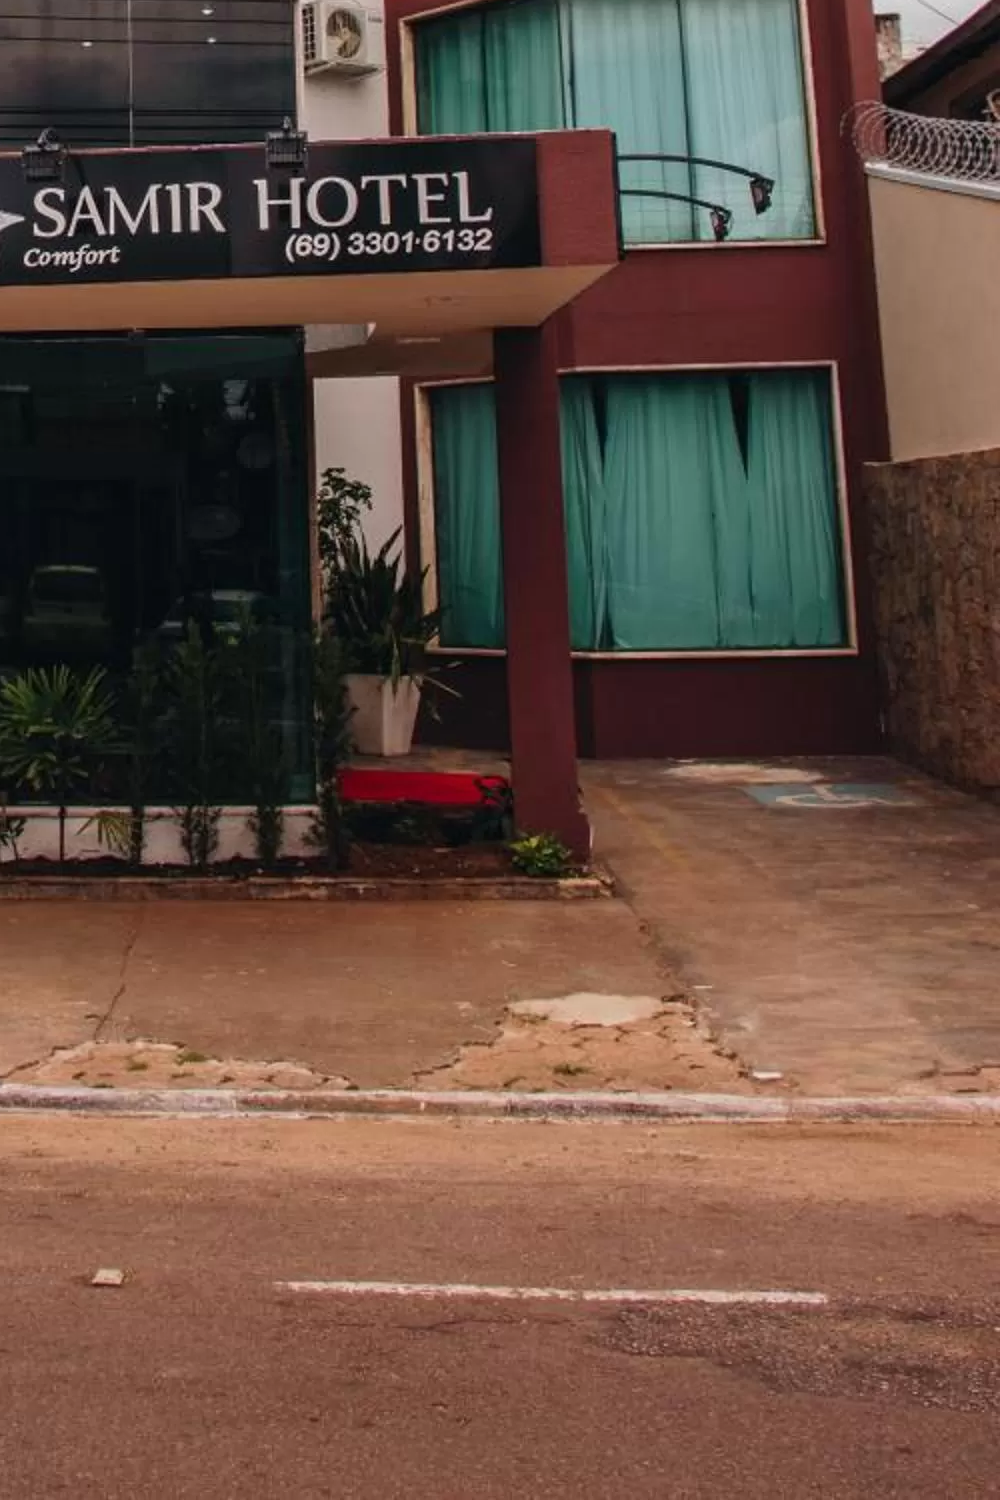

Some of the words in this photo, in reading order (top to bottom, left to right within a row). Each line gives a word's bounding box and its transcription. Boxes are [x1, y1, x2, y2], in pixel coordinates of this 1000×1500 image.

[32, 181, 226, 238] SAMIR
[252, 171, 493, 231] HOTEL
[23, 243, 121, 273] Comfort
[285, 232, 341, 263] (69)
